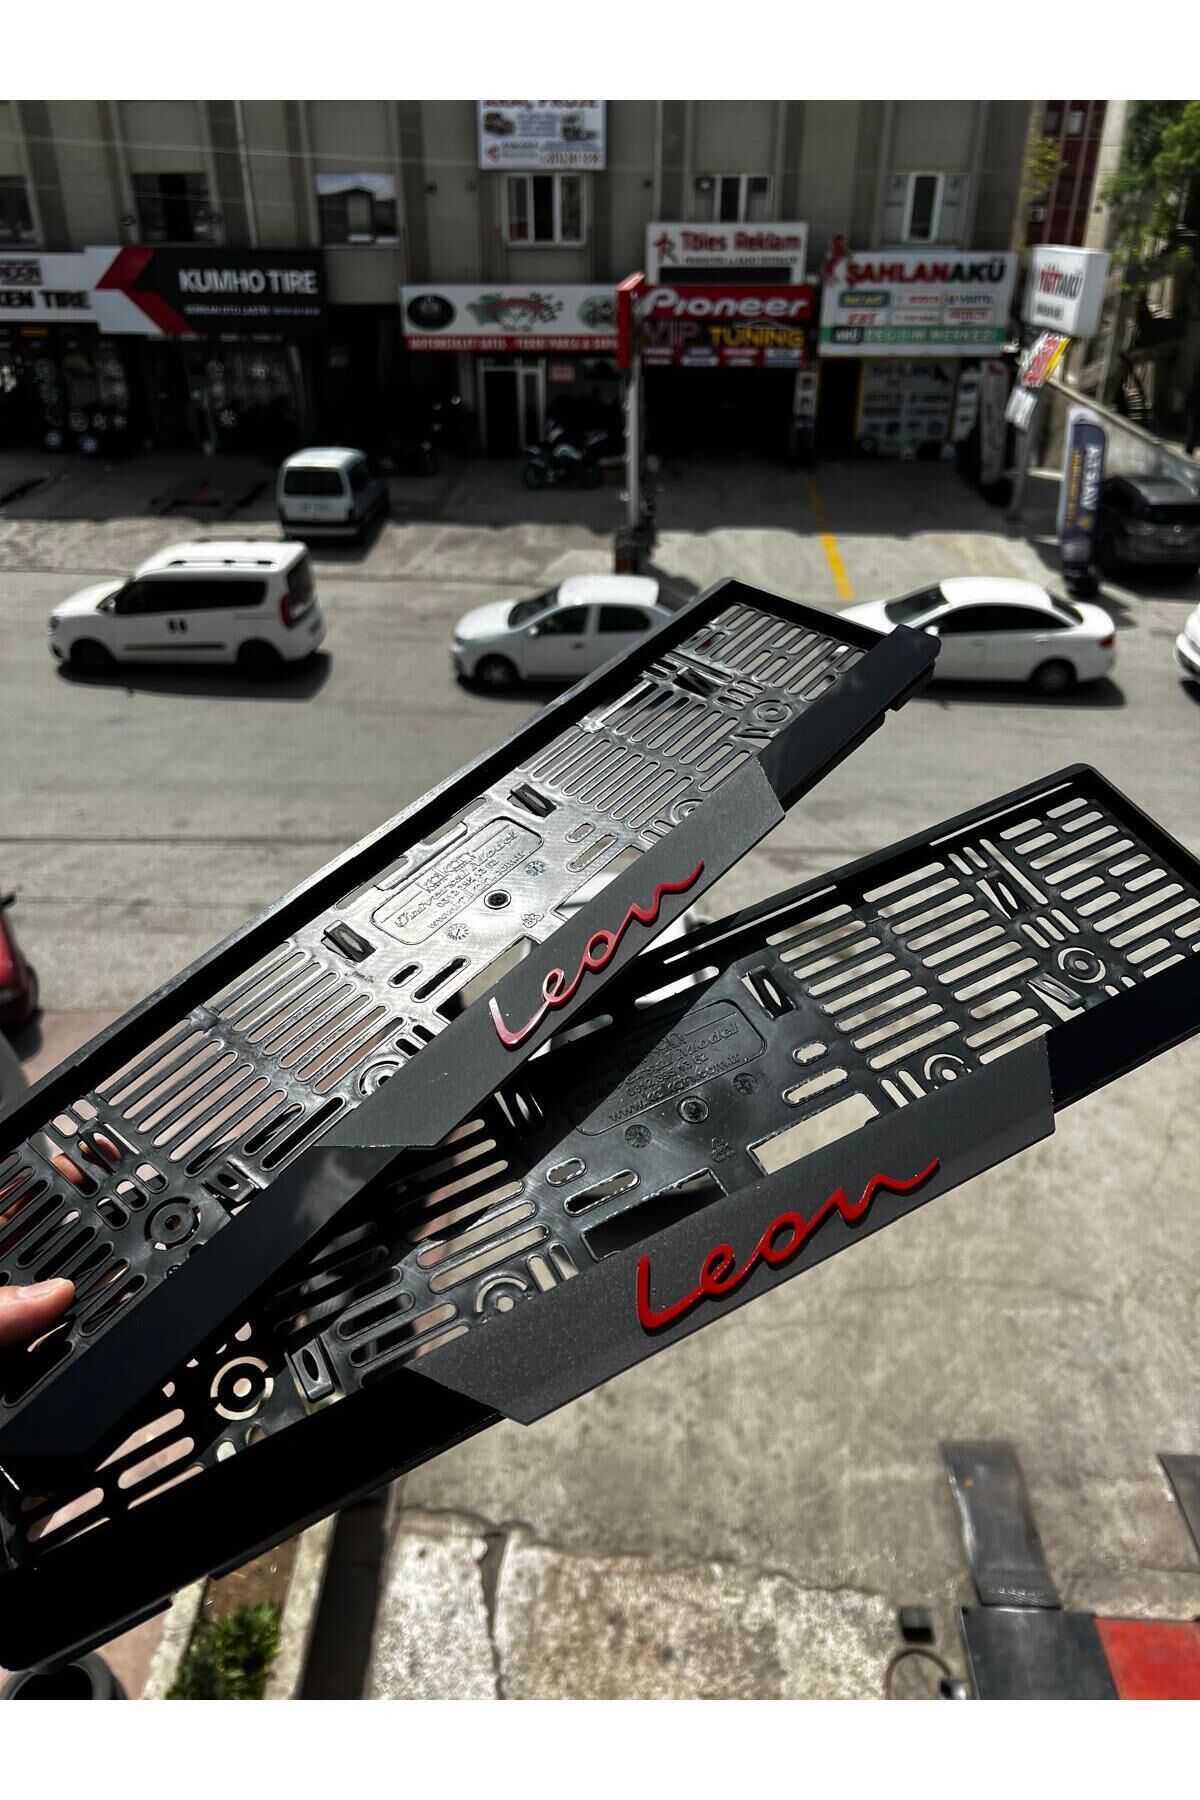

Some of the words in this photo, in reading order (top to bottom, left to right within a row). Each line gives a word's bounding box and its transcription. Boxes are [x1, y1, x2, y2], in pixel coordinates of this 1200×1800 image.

[177, 267, 265, 294] KUMHO
[266, 268, 319, 295] TIRE
[641, 287, 809, 318] Pioneer
[642, 320, 700, 346] VIP
[707, 325, 805, 347] TUNING
[488, 860, 704, 1051] Leon
[673, 1019, 740, 1061] Model
[636, 1158, 940, 1336] Leon
